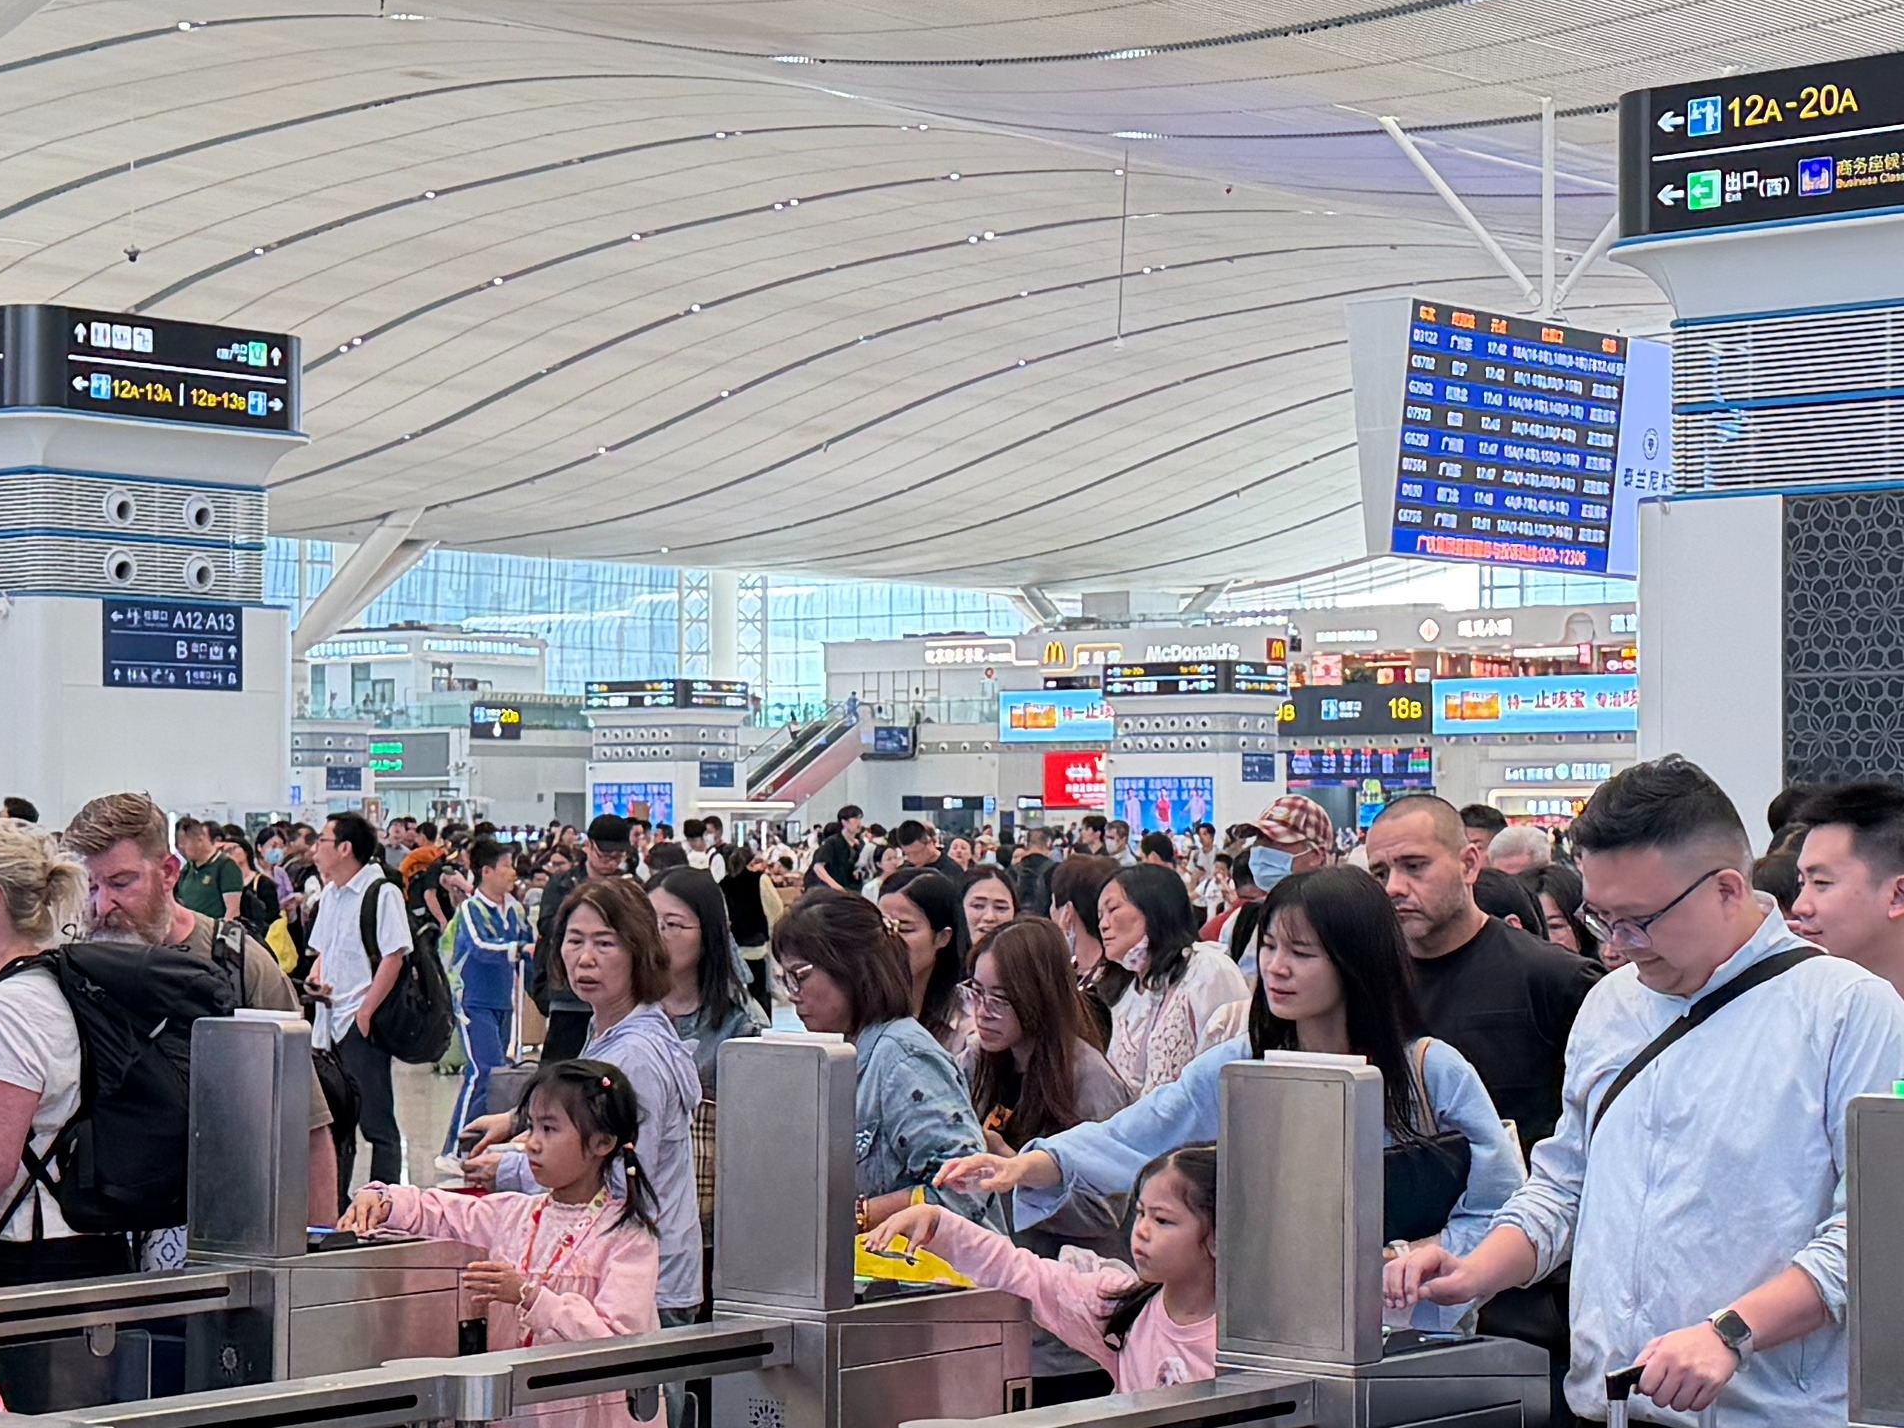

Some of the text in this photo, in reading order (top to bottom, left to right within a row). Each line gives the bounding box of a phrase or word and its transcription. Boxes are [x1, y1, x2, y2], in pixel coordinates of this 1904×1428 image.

[1727, 84, 1859, 128] 12A-20A
[1725, 170, 1758, 192] 出口
[112, 379, 246, 411] 12A-13A 12B-13B
[176, 640, 188, 659] B
[1146, 642, 1240, 663] McDonald's
[1388, 696, 1423, 719] 18B
